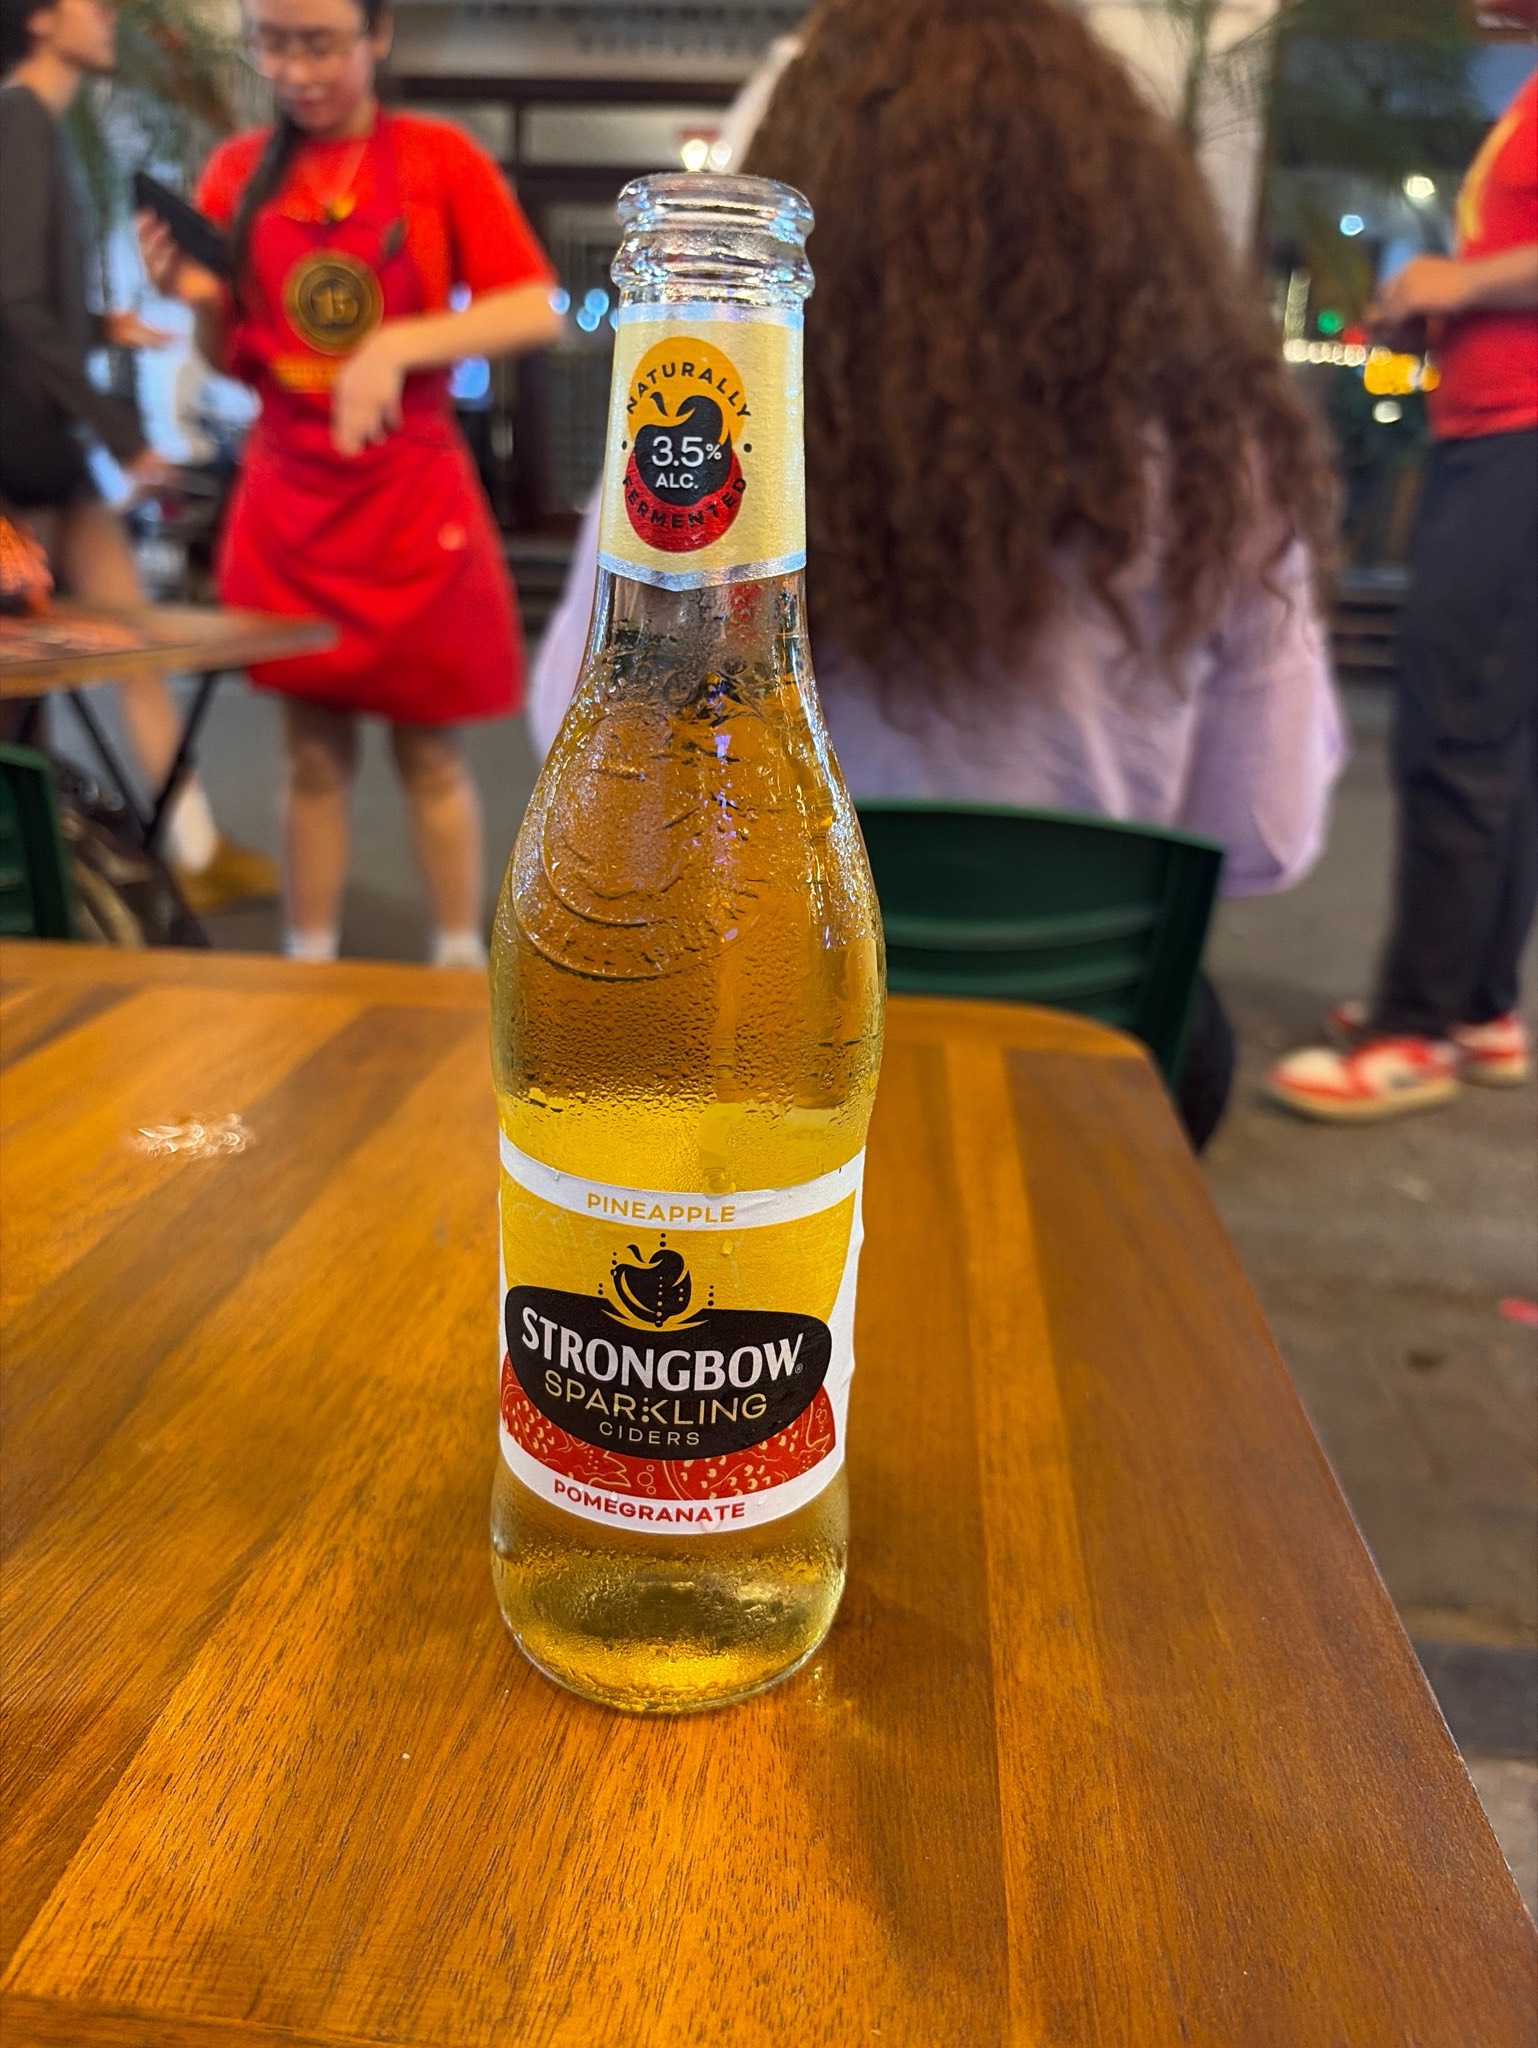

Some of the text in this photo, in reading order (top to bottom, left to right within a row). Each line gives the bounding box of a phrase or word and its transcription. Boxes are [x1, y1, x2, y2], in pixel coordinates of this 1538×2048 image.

[627, 362, 751, 416] NATURALLY
[651, 435, 722, 467] 3.5%
[623, 477, 747, 528] FERMENTED
[655, 473, 699, 489] ALC.
[587, 1192, 736, 1223] PINEAPPLE
[521, 1306, 803, 1391] STRONGBOW
[545, 1369, 767, 1425] SPARKLING
[599, 1421, 700, 1445] CIDERS
[554, 1478, 746, 1522] POMEGRANATE
